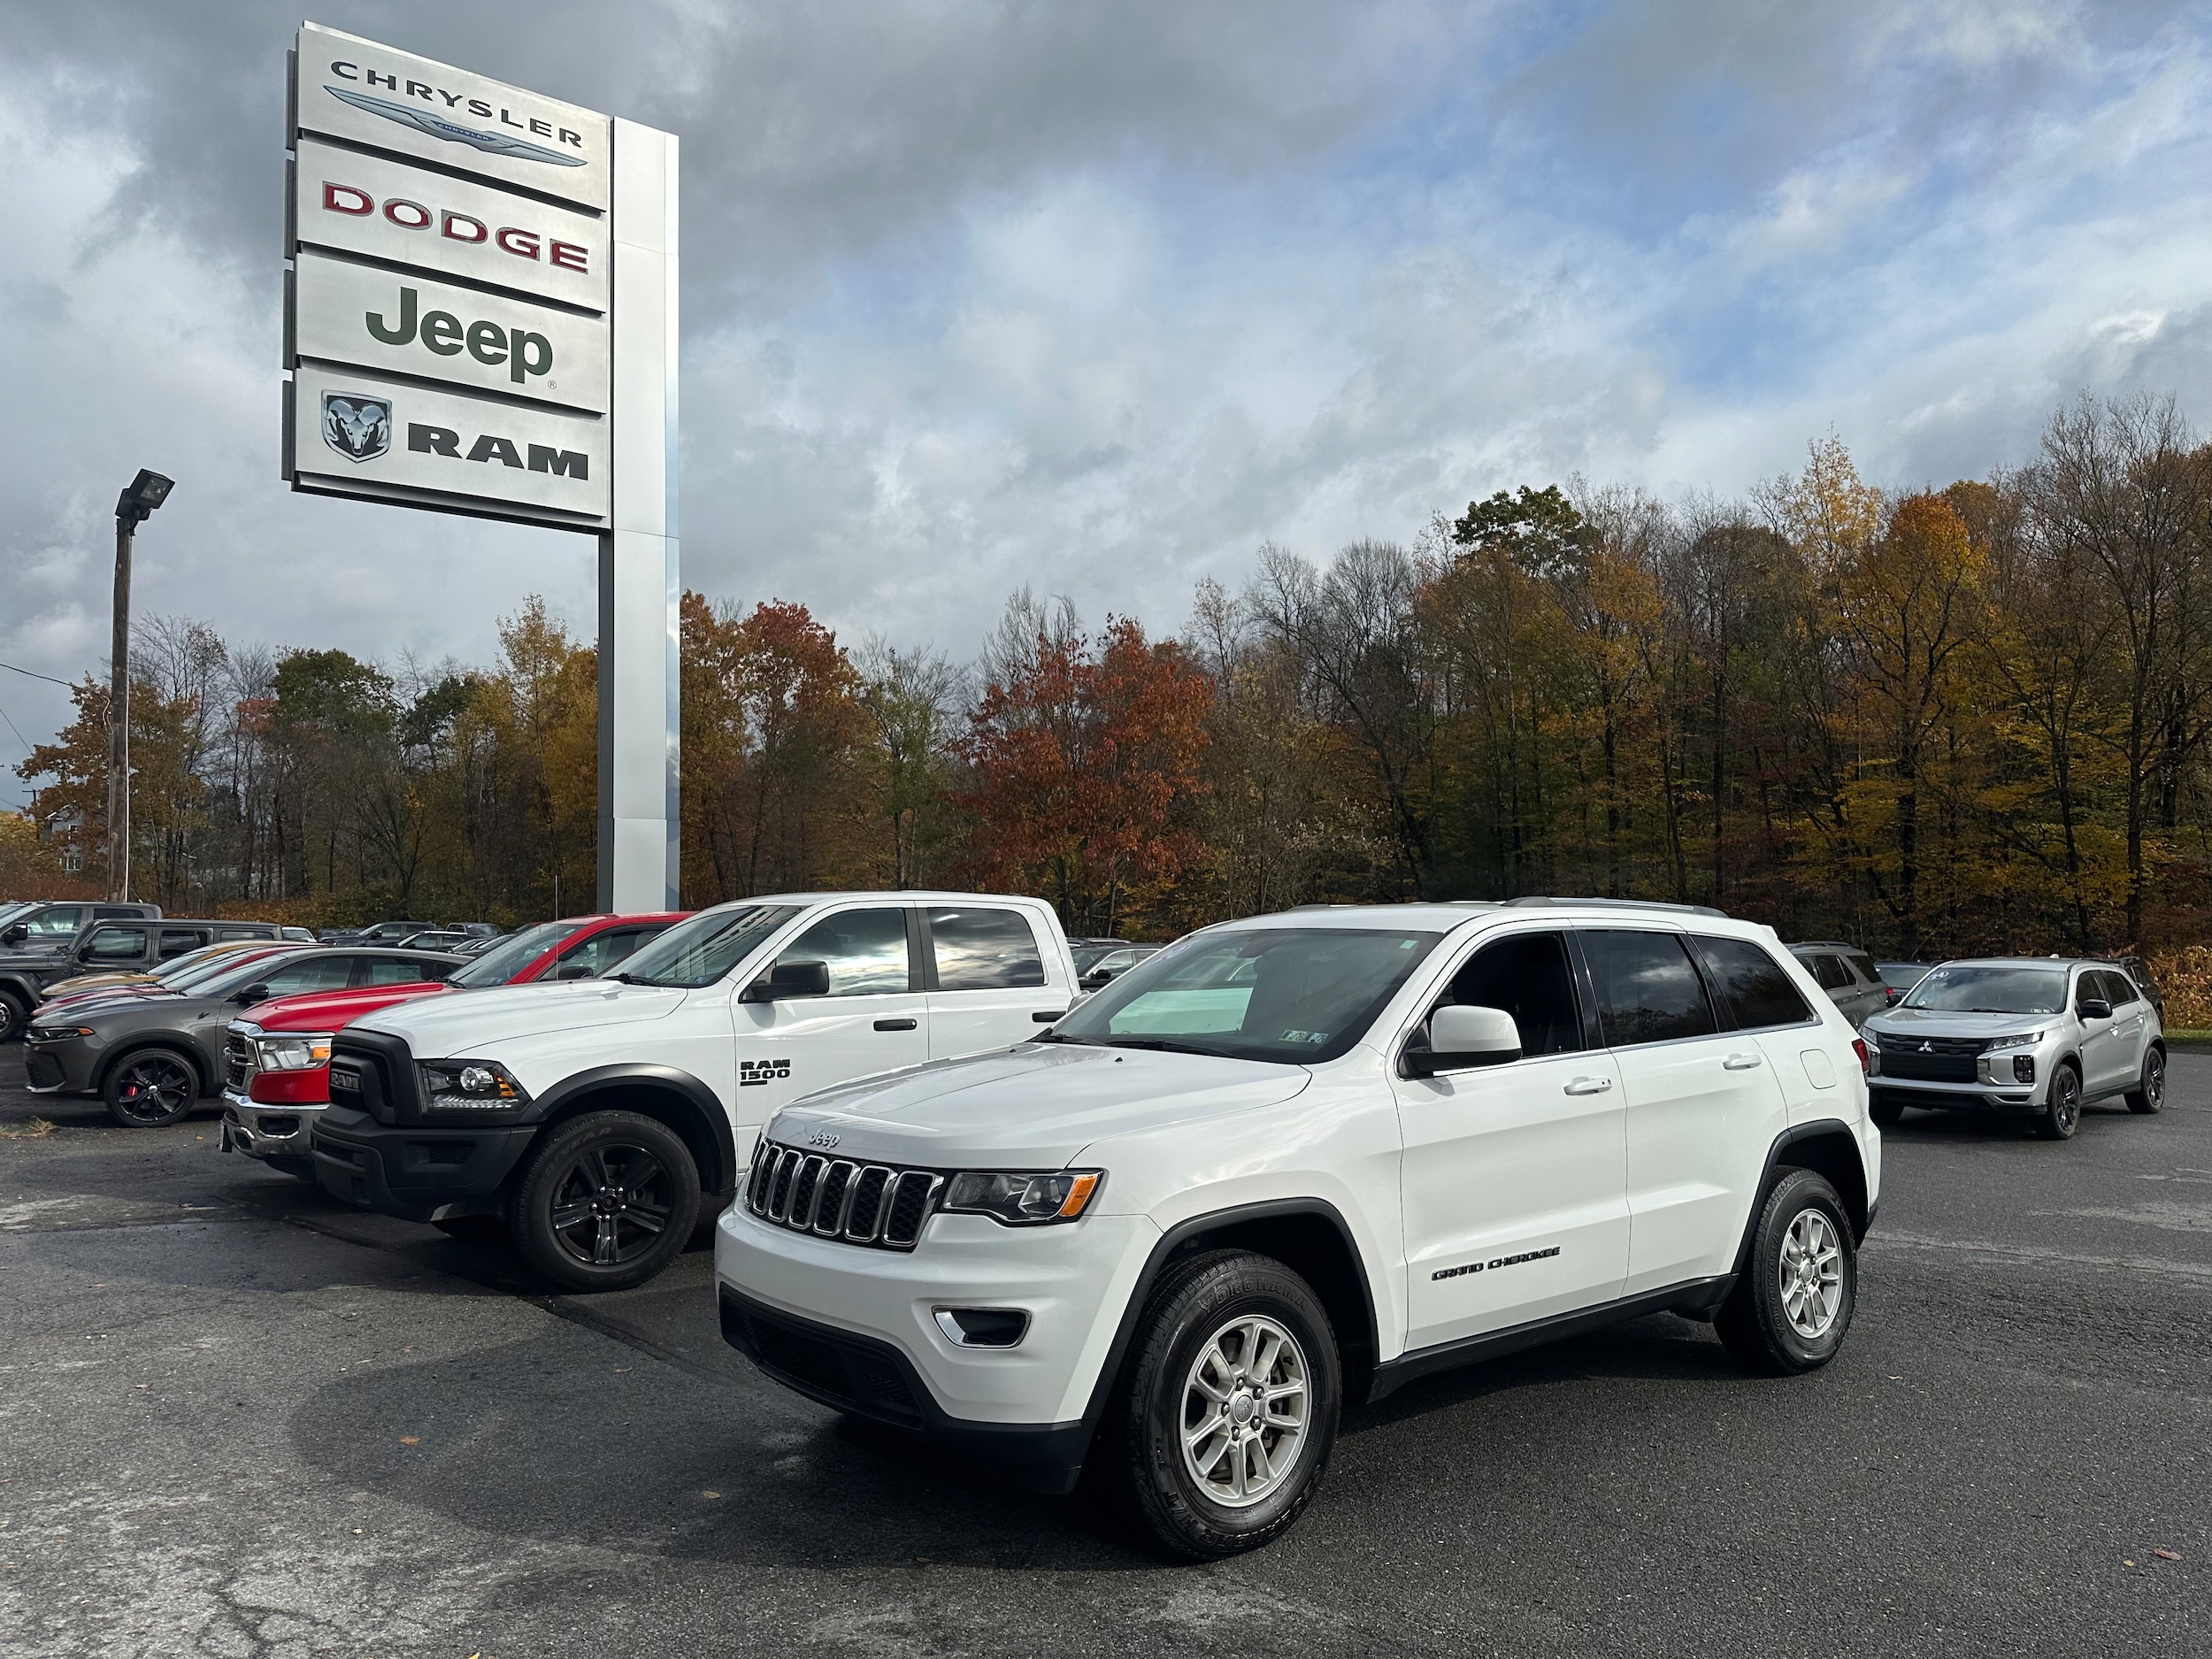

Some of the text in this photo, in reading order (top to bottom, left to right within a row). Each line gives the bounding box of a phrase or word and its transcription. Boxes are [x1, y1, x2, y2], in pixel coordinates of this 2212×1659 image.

[330, 60, 582, 149] CHRYSLER
[322, 180, 588, 275] DODGE
[365, 286, 553, 383] Jeep
[407, 422, 589, 481] RAM
[331, 1072, 359, 1090] RAM
[740, 1069, 790, 1080] 1500
[741, 1059, 790, 1070] RAM
[809, 1127, 841, 1151] Jeep
[1432, 1246, 1561, 1281] GRAND CHEROKEE
[1197, 1275, 1309, 1314] YOKOHAMA
